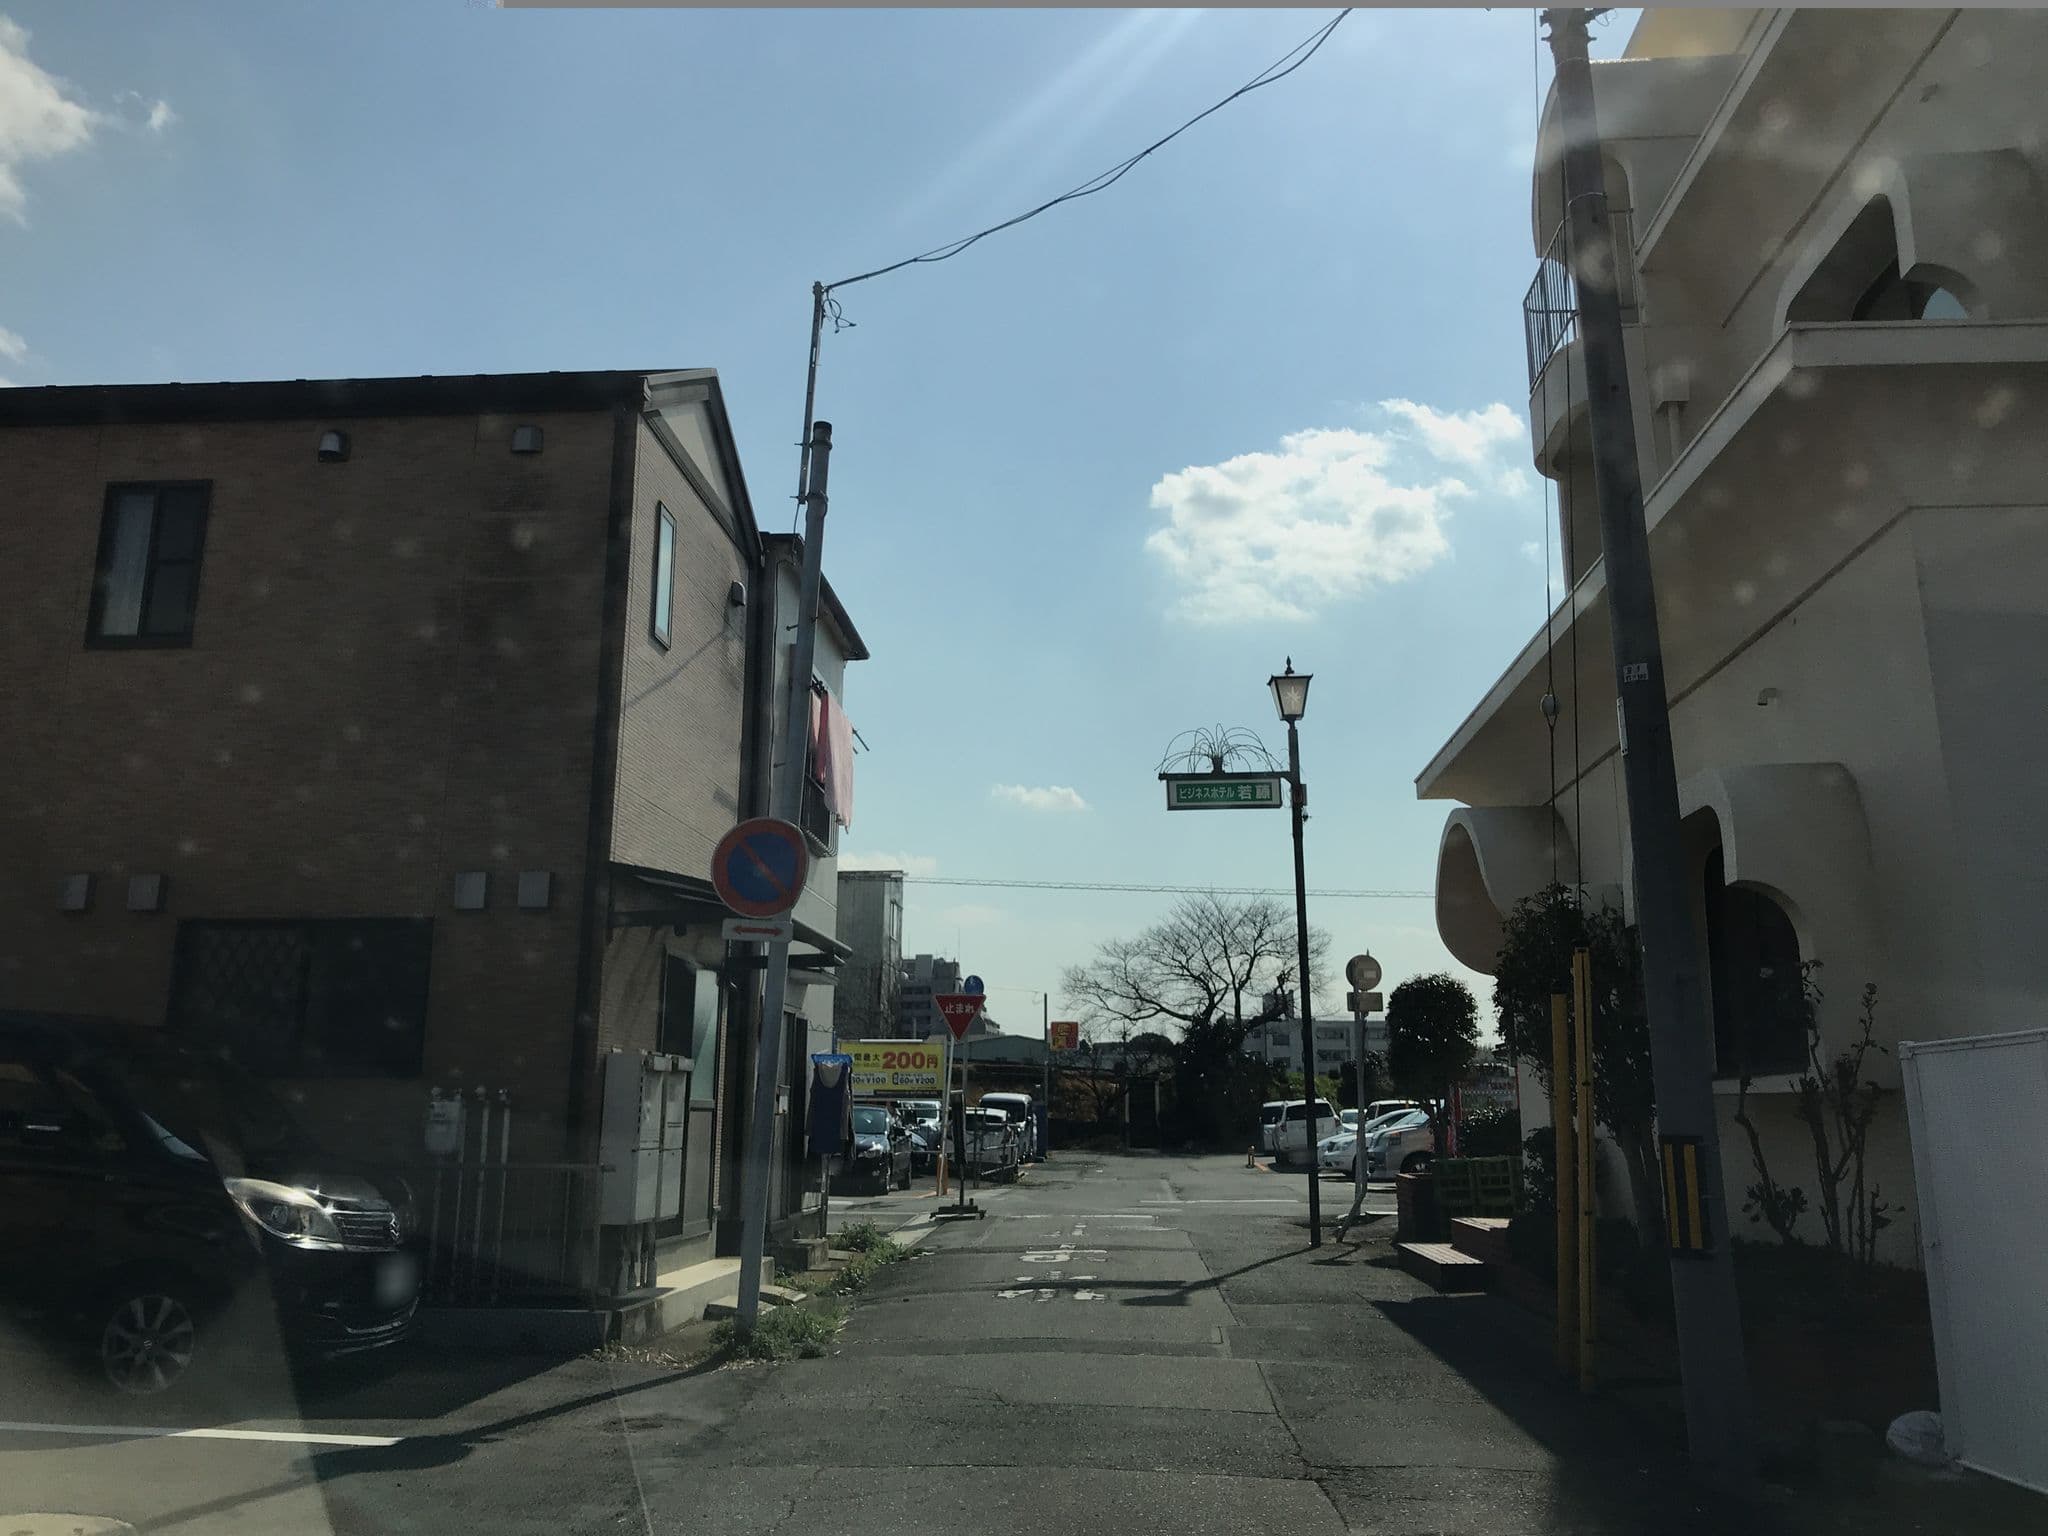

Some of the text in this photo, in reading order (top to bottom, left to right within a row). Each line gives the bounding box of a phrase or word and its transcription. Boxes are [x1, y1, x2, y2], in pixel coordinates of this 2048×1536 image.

[1179, 786, 1235, 799] ビジネスホテル
[944, 1002, 975, 1015] 止まれ
